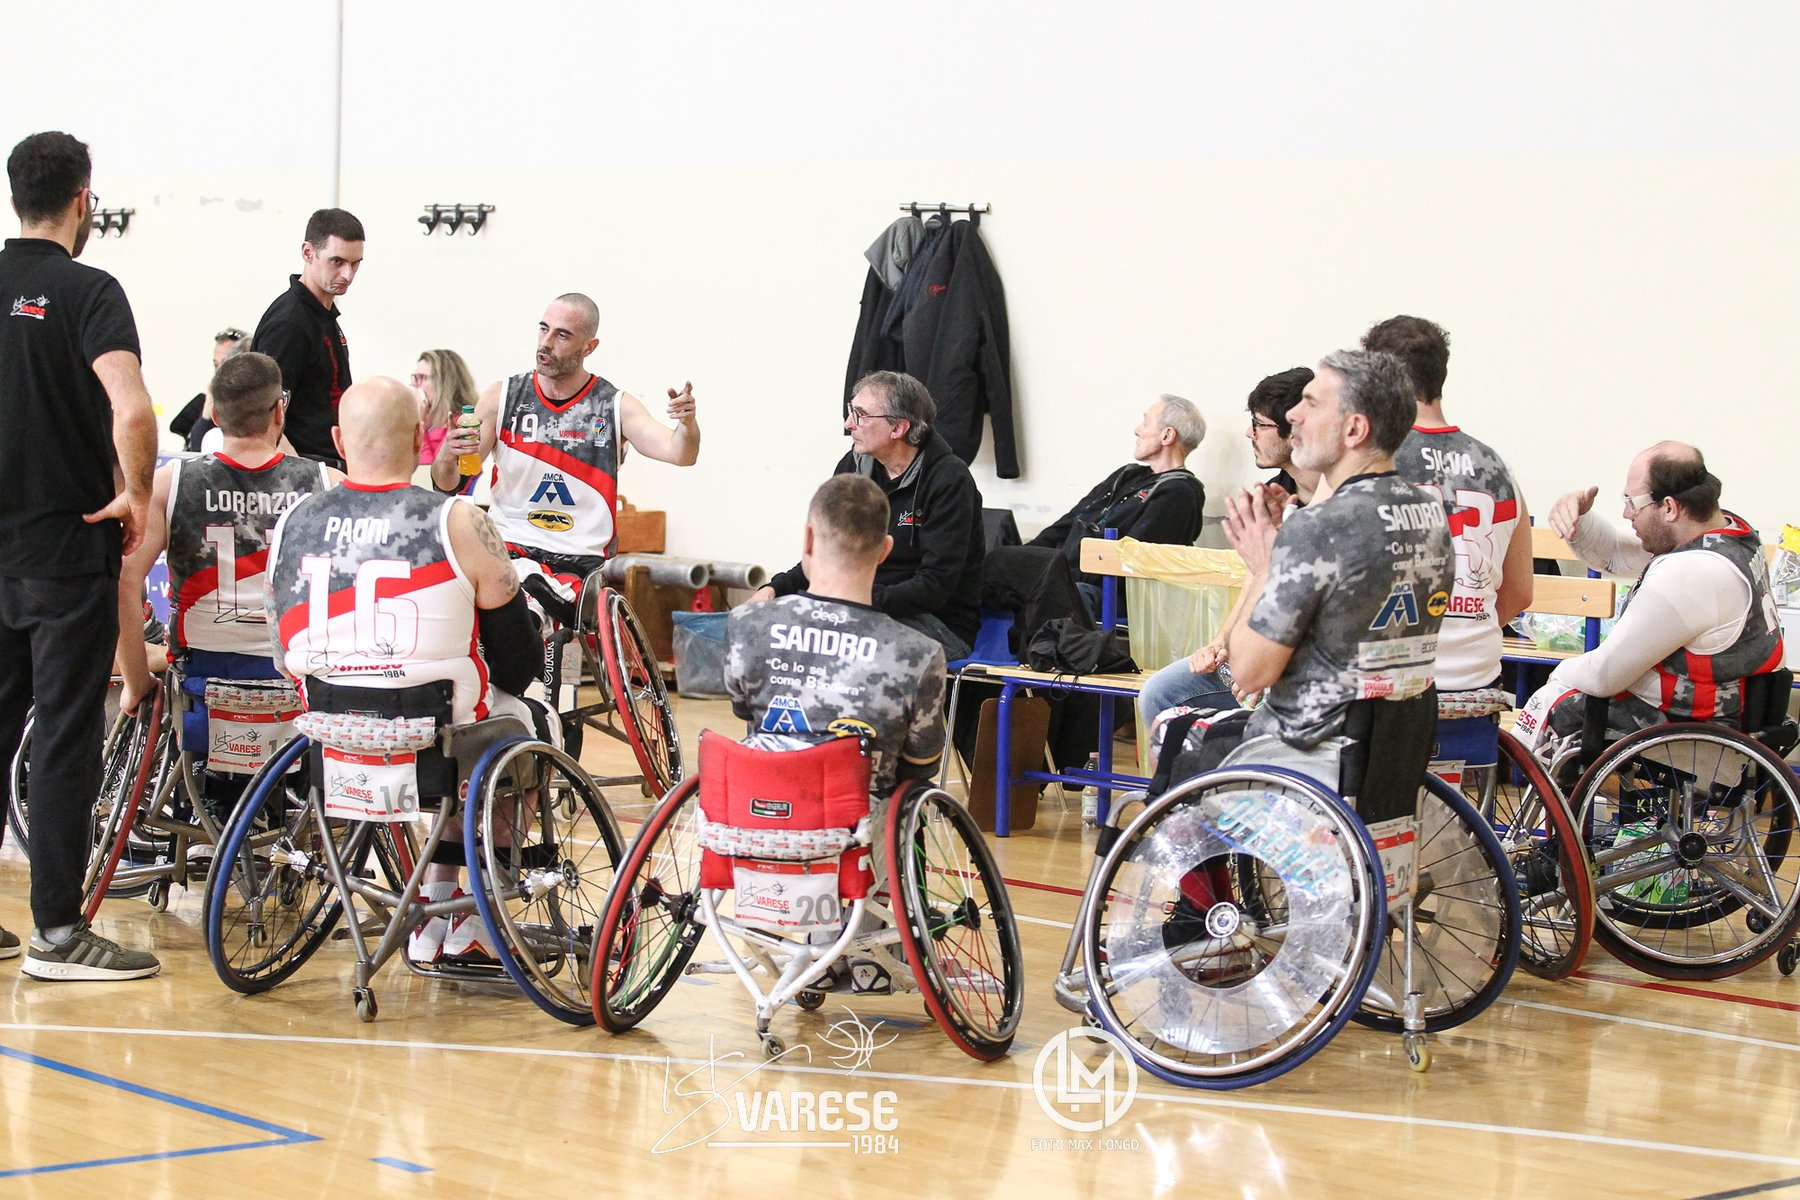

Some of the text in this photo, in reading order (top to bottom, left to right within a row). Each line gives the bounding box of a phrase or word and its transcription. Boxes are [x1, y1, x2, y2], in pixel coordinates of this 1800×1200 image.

[510, 413, 539, 443] 19
[1421, 447, 1476, 477] SILVA
[542, 473, 564, 482] AMCA
[1377, 501, 1445, 532] SANDRO
[206, 526, 274, 616] 1
[301, 555, 418, 659] 16
[770, 623, 878, 662] SANDRO
[383, 670, 405, 678] 1984
[793, 661, 805, 673] lo
[229, 743, 261, 754] VARESE
[344, 785, 373, 800] VARESE
[380, 783, 416, 814] 16
[756, 895, 790, 910] VARESE
[796, 893, 836, 925] 20
